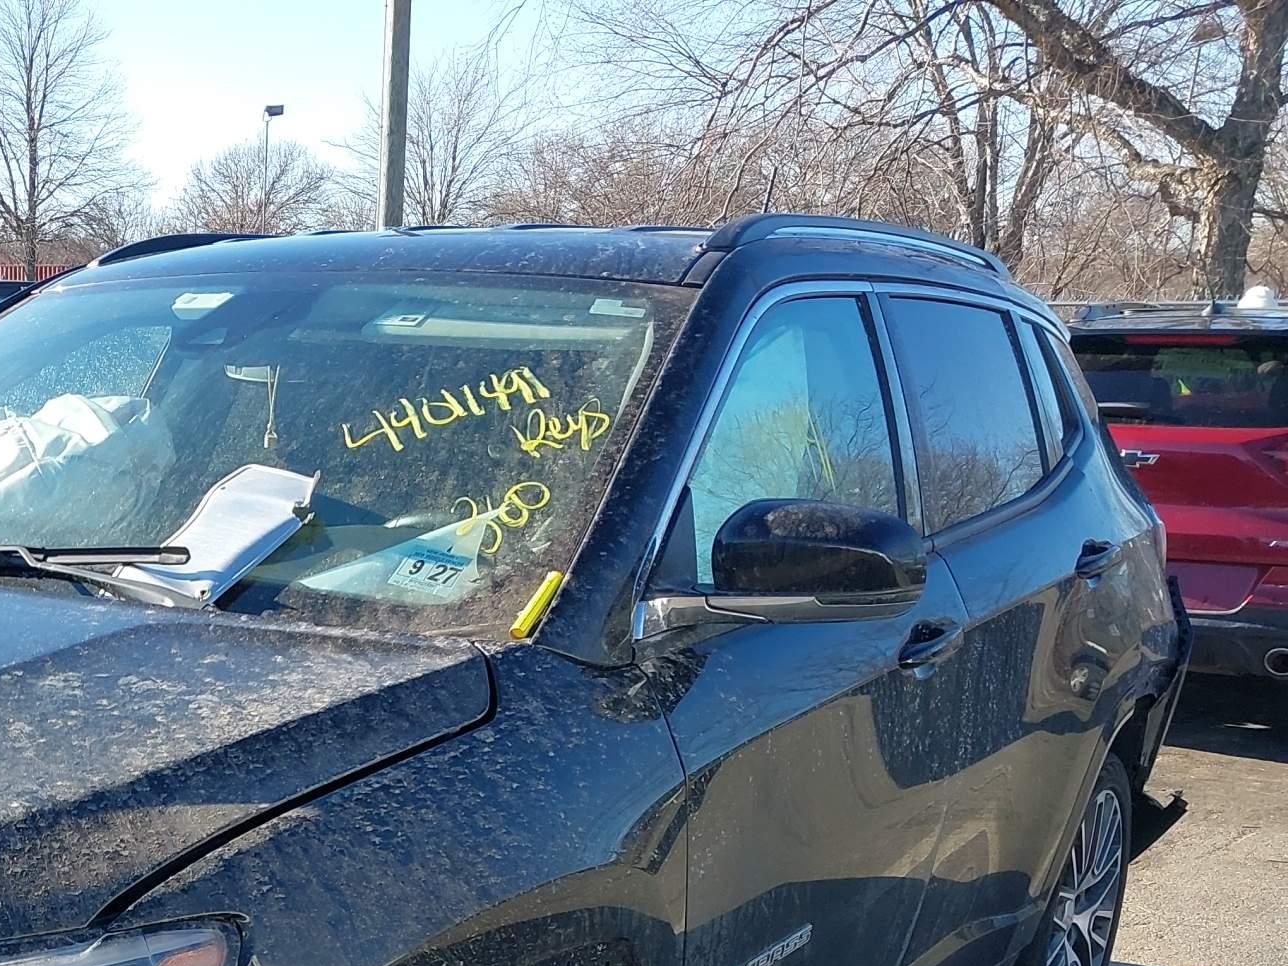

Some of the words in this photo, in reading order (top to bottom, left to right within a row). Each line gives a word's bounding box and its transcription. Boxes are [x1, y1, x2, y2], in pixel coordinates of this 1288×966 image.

[342, 366, 551, 452] 44011491
[408, 559, 425, 576] 9
[427, 563, 464, 585] 27
